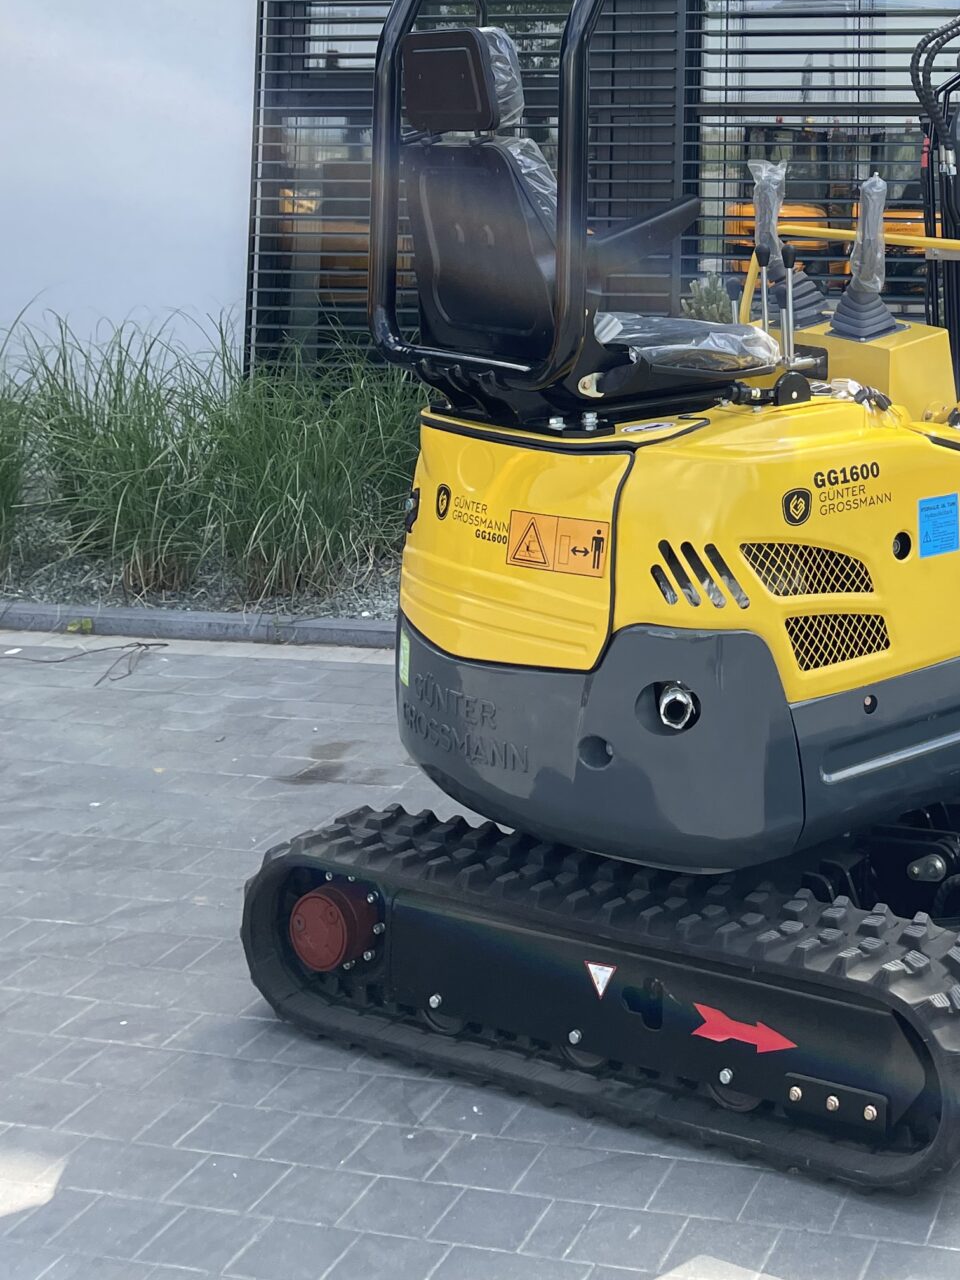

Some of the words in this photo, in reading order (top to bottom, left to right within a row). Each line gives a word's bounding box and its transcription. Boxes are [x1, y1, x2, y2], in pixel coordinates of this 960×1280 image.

[814, 462, 880, 489] GG1600
[819, 484, 867, 503] GÜNTER
[820, 492, 893, 516] GROSSMANN
[454, 495, 488, 515] GÜNTER
[452, 509, 510, 533] GROSSMANN
[475, 529, 508, 544] GG1600
